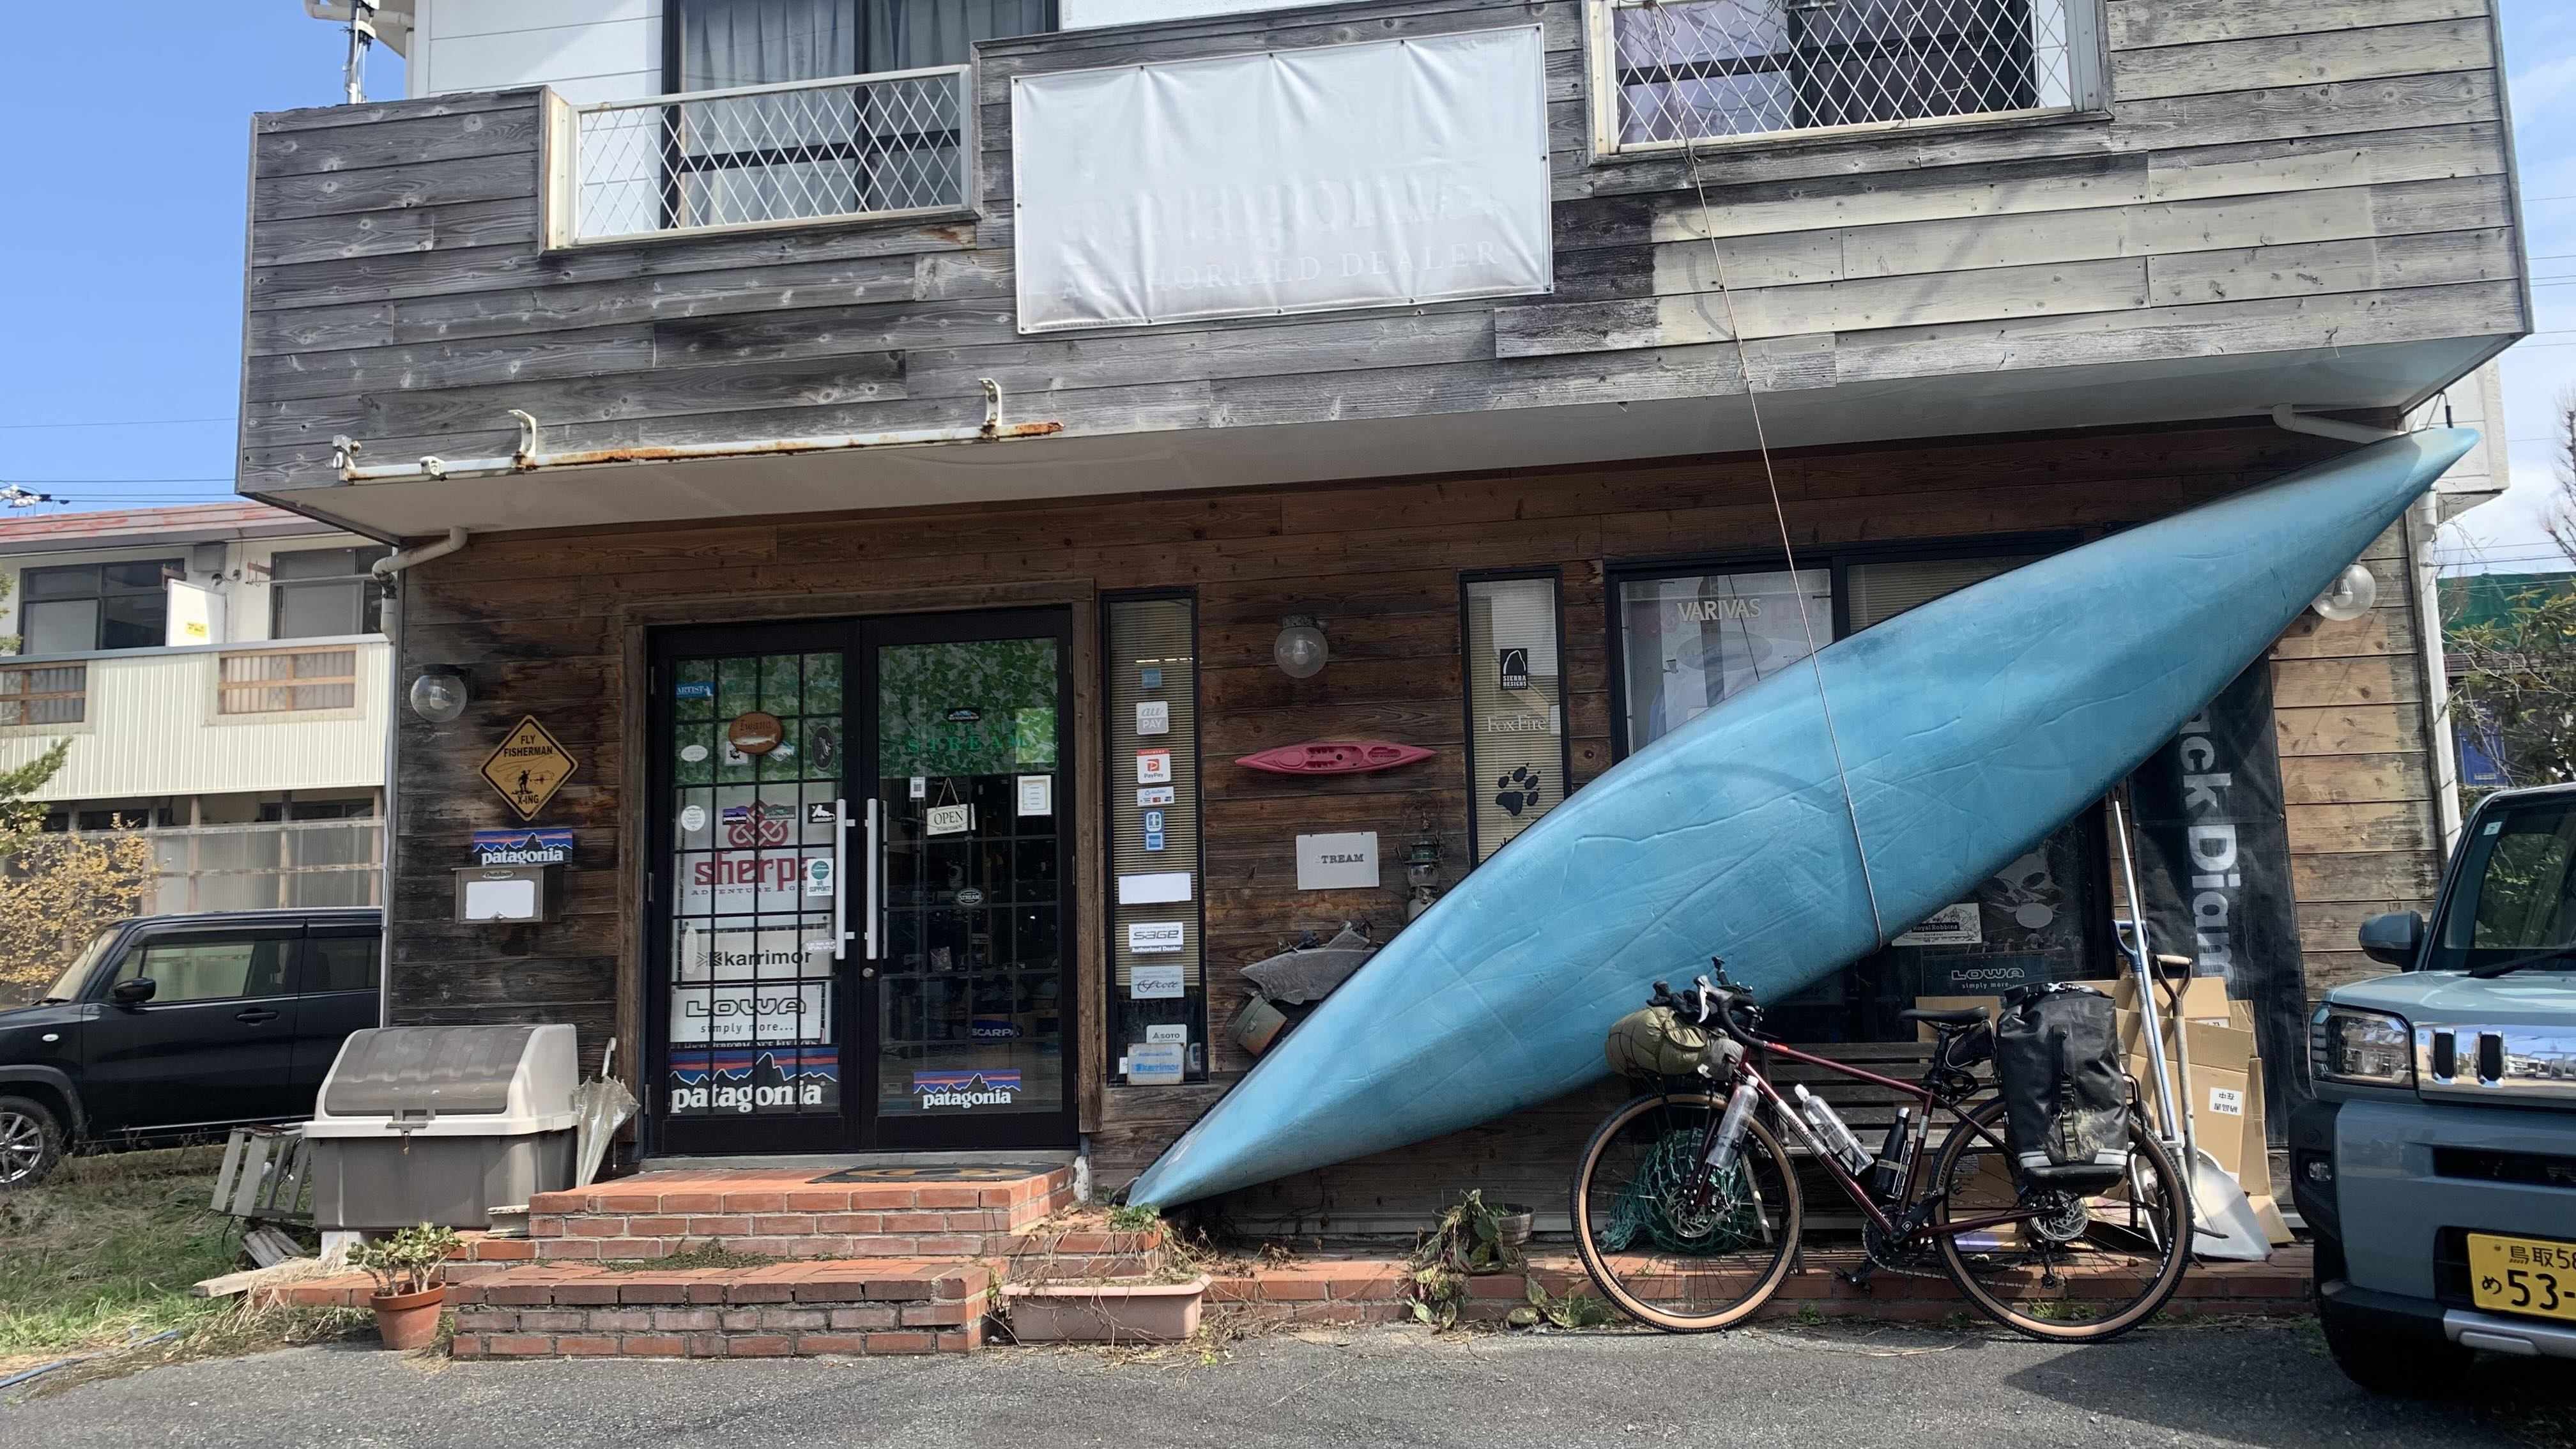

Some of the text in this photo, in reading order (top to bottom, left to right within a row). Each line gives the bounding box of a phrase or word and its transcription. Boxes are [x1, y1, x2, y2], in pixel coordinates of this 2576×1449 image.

[1340, 241, 1499, 277] DEALER
[1676, 598, 1763, 622] VARIVAS
[1142, 719, 1162, 728] PAY
[521, 735, 536, 744] FLY
[907, 735, 1027, 753] STREAM
[504, 746, 553, 758] FISHERMAN
[517, 793, 539, 804] X-ING
[934, 810, 963, 825] OPEN
[481, 848, 564, 865] patagonia
[1315, 854, 1364, 864] TREAM
[1951, 968, 2025, 980] LOWA
[686, 997, 806, 1017] LOWA
[670, 1080, 823, 1114] patagonia
[922, 1089, 1012, 1109] patagonia
[2482, 1275, 2502, 1295] め
